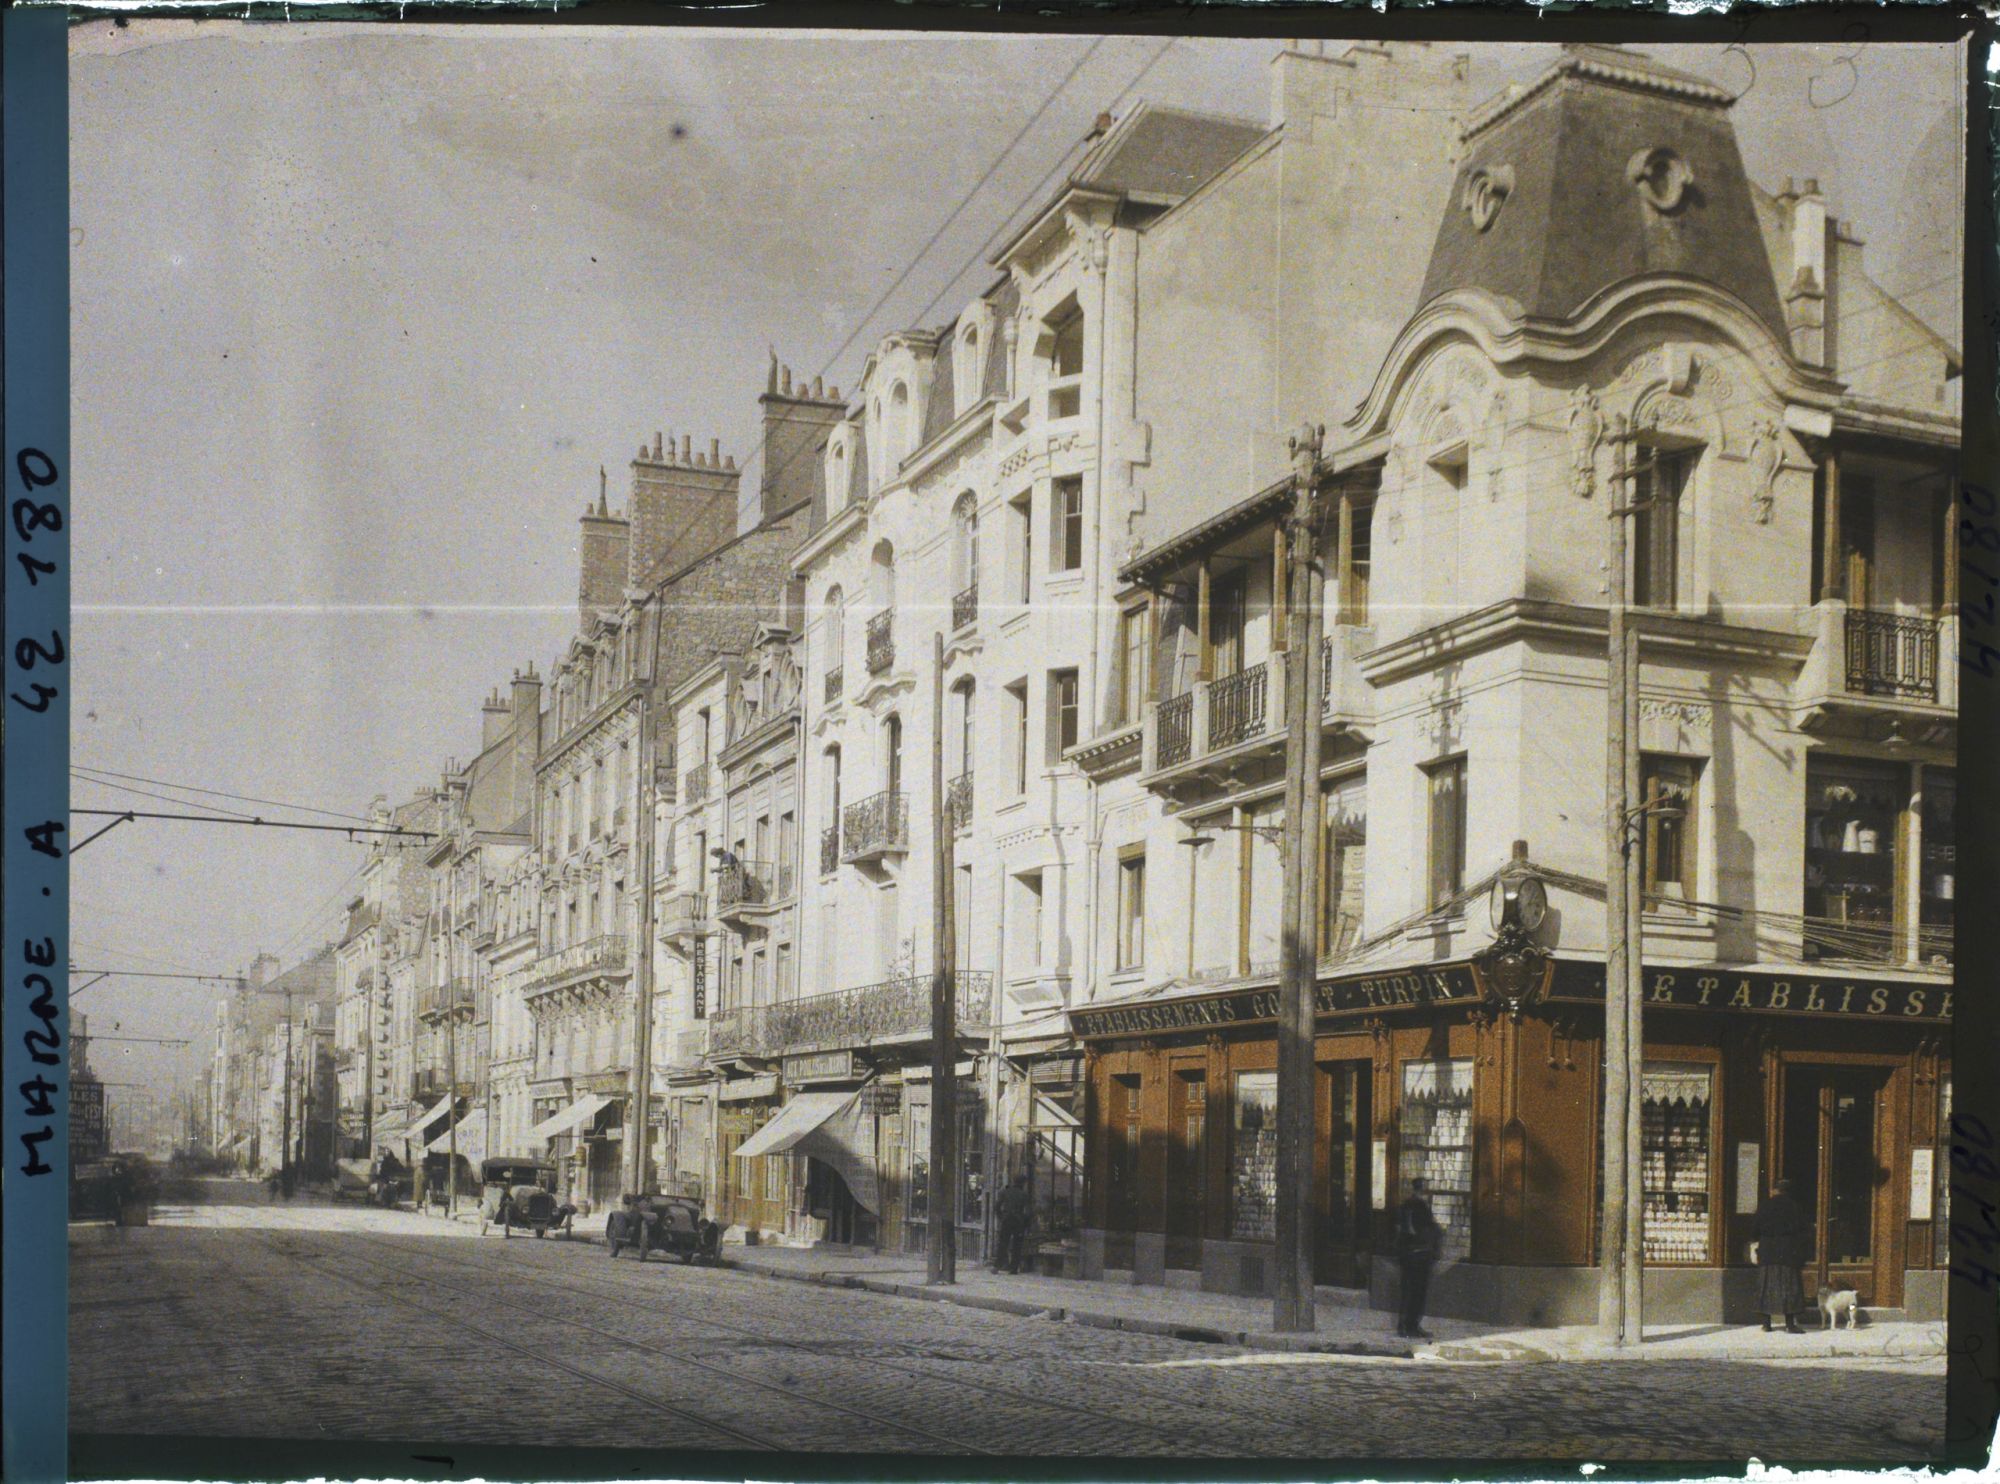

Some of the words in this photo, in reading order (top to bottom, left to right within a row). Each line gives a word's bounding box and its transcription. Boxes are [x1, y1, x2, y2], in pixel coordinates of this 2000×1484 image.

[11, 447, 63, 587] 180
[10, 629, 66, 714] 42
[23, 820, 66, 859] A
[696, 942, 704, 1013] RESTAURANT
[1086, 999, 1236, 1035] ETABLISSEMENTS
[1361, 972, 1453, 1008] TURPIN
